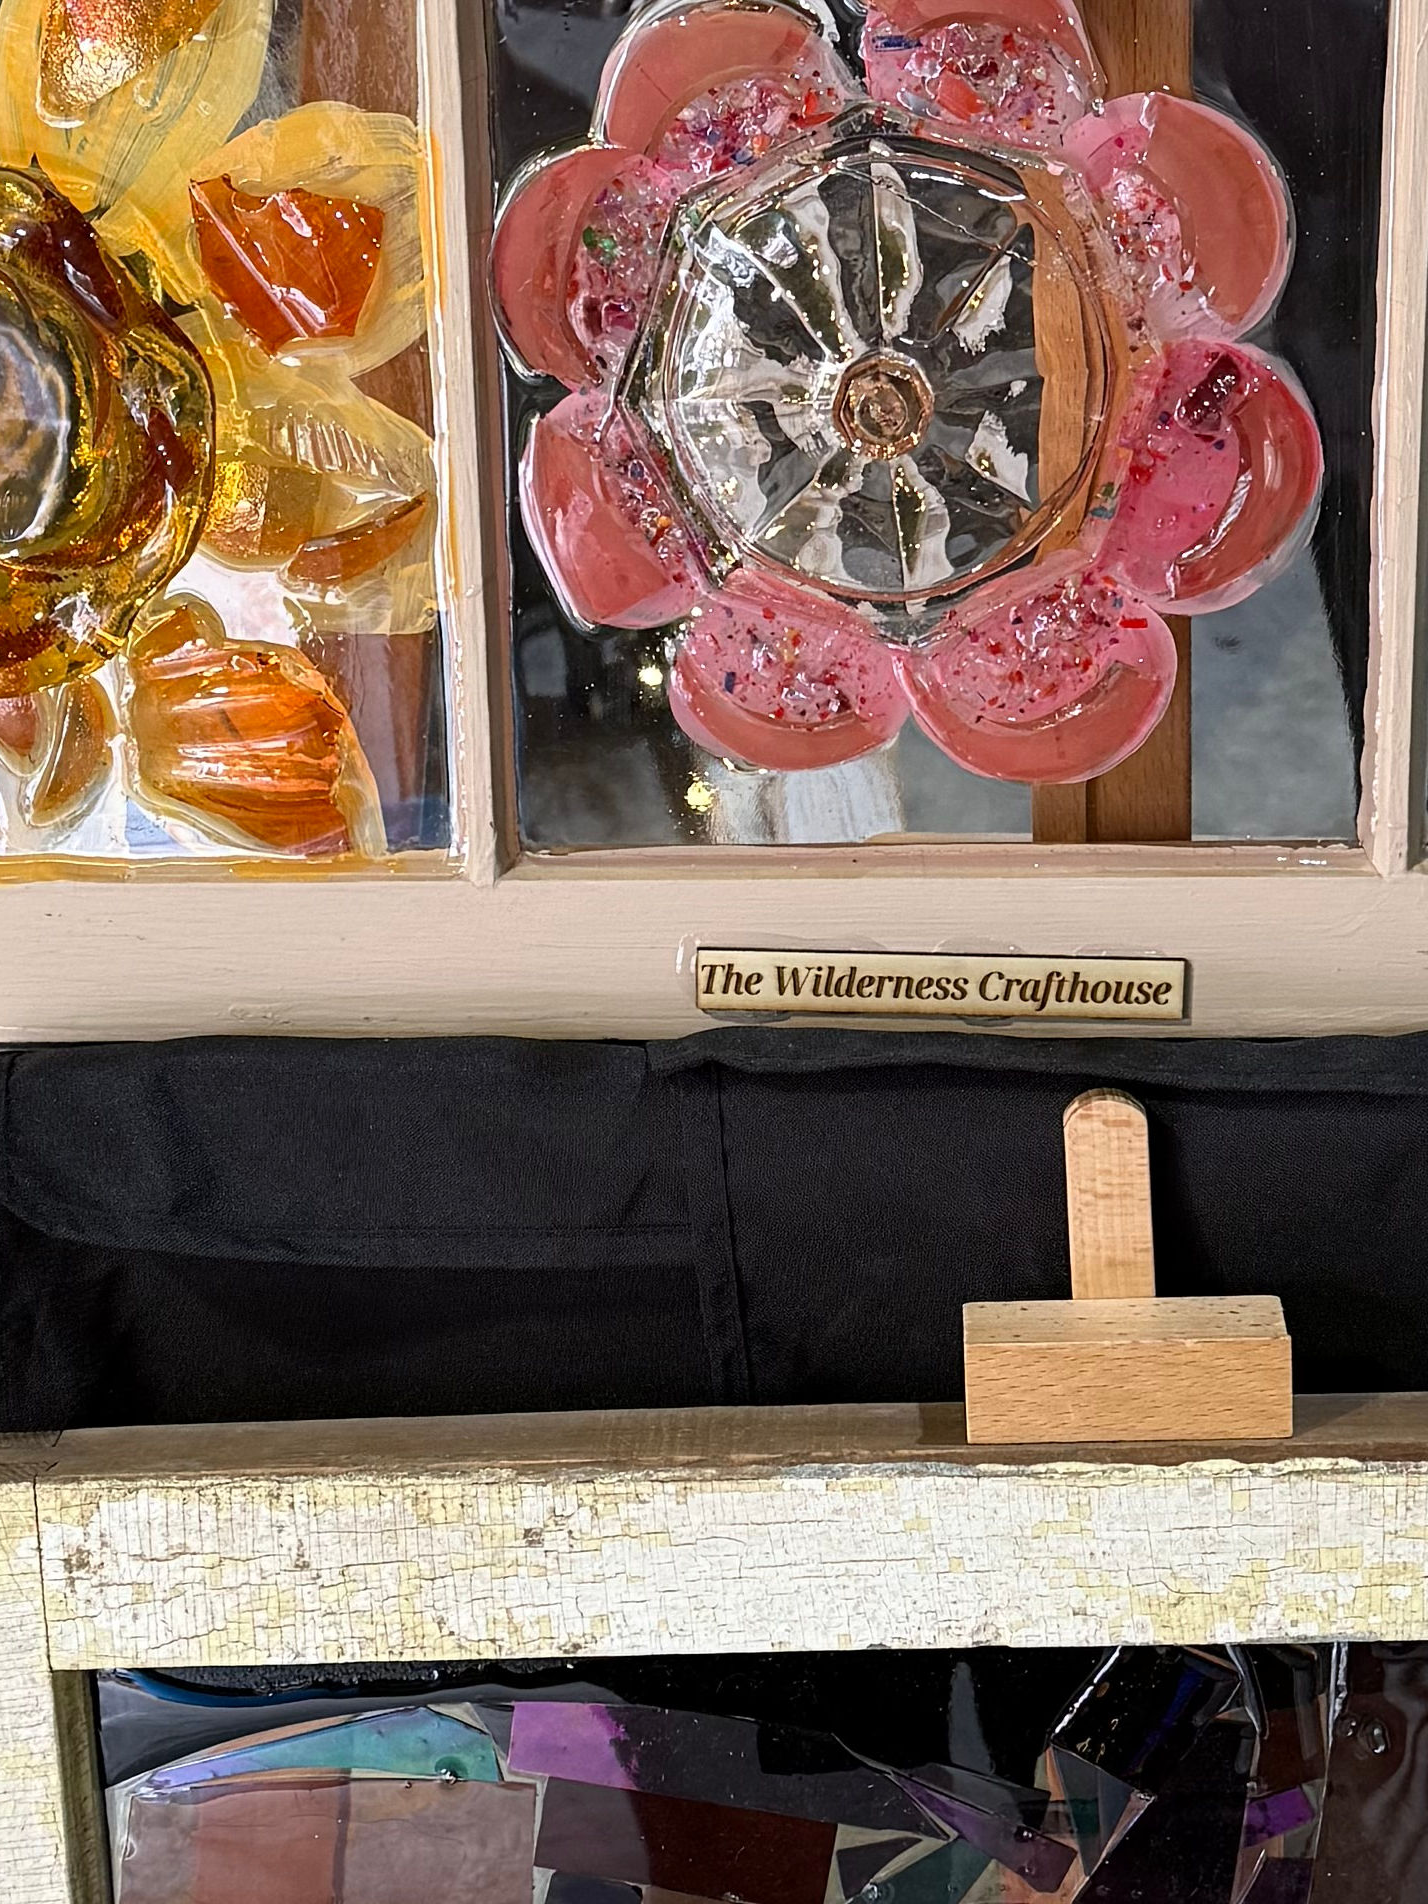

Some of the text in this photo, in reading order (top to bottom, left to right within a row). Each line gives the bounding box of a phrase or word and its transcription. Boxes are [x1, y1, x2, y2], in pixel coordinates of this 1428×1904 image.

[701, 963, 1173, 1012] The Wilderness Crafthouse
